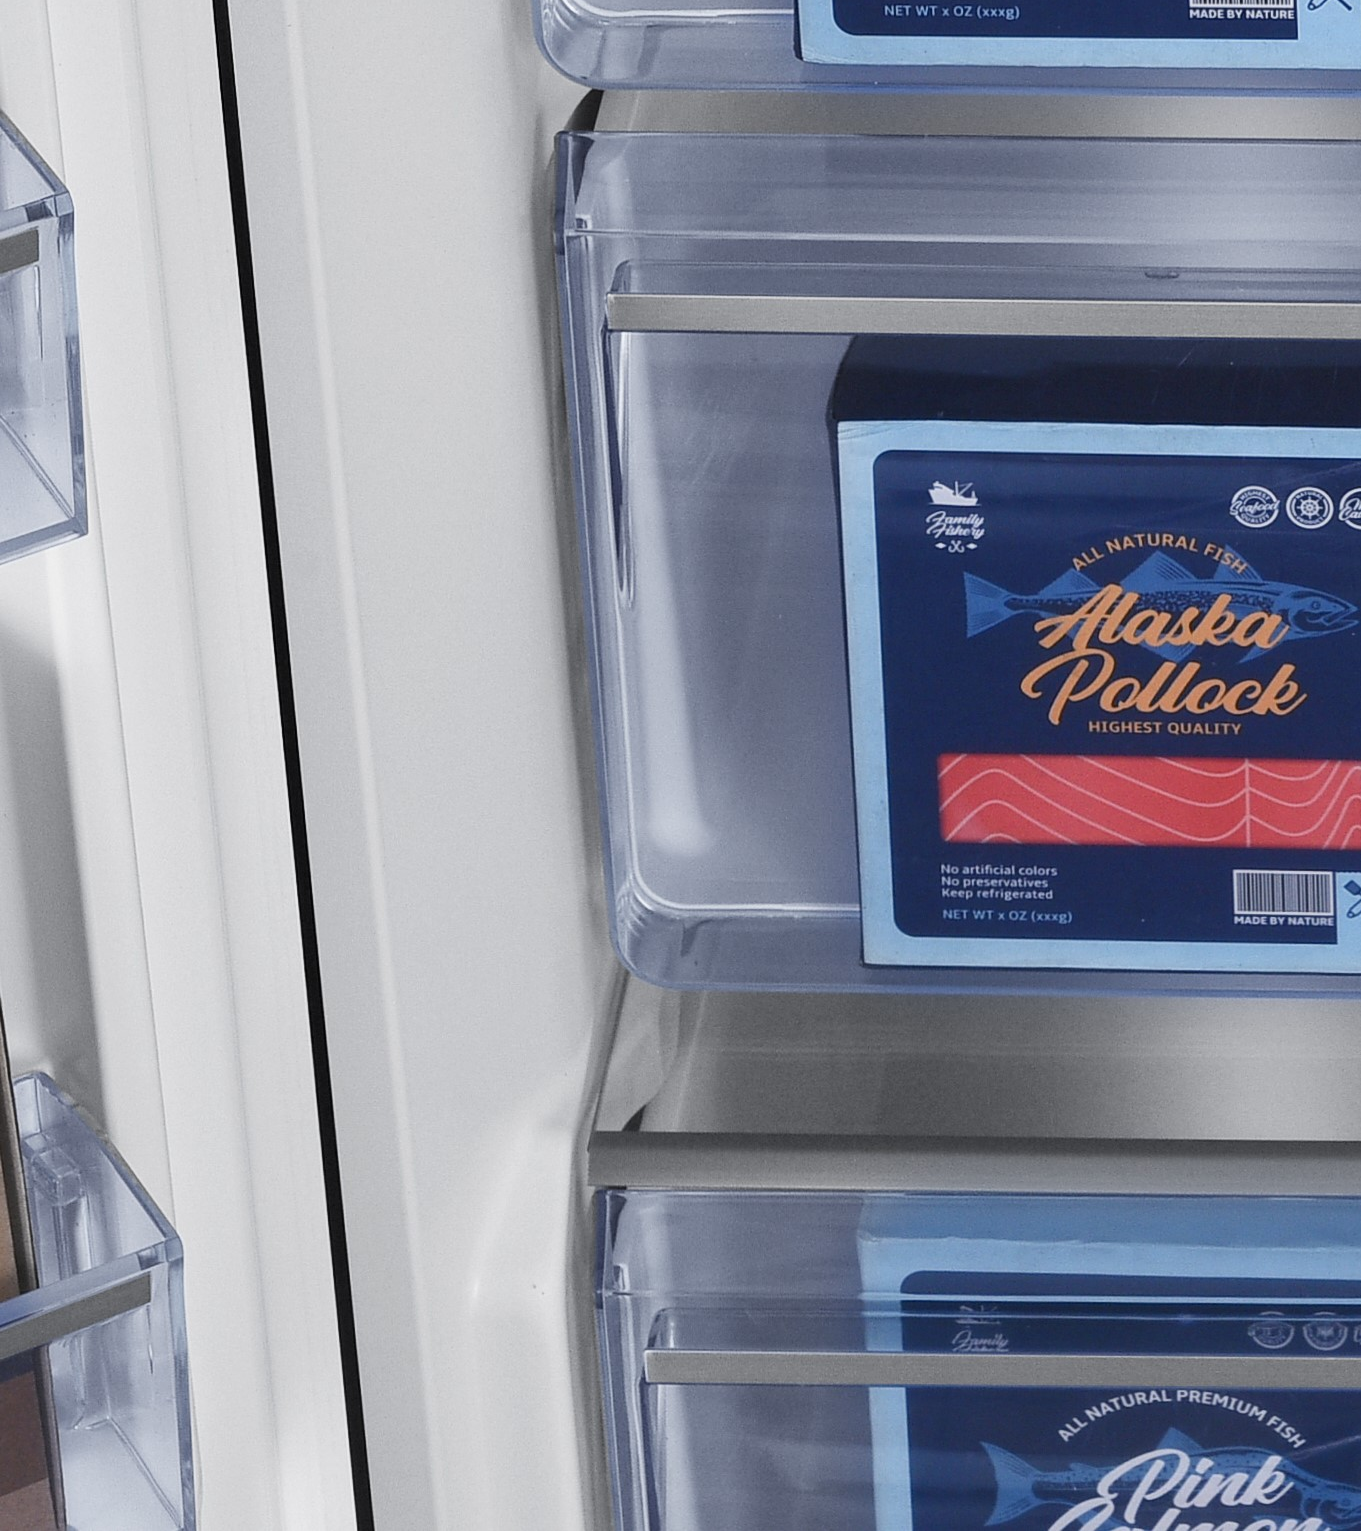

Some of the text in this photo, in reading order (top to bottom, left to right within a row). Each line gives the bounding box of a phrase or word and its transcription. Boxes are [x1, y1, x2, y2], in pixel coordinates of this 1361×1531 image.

[884, 5, 1020, 20] NET WT x OZ (xxxg)
[1189, 9, 1295, 19] MADE BY NATURE
[1240, 490, 1271, 501] HIGHEST
[1295, 491, 1323, 500] NATURAL
[1229, 500, 1281, 516] Seafood
[925, 510, 985, 528] Family
[1240, 513, 1270, 523] QUALITY
[926, 523, 985, 540] Fishery
[1072, 533, 1249, 575] ALL NATURAL FISH
[1034, 584, 1290, 651] Alaska
[1020, 648, 1308, 726] Pollock
[1089, 721, 1241, 735] HIGHEST QUALITY
[940, 864, 1058, 876] No artificial colors
[941, 876, 1049, 888] No preservatives
[941, 888, 1053, 901] Keep refrigerated
[943, 909, 1073, 924] NET WT x OZ (xxxg)
[1234, 916, 1334, 926] MADE BY NATURE
[951, 1329, 1009, 1348] Family
[1057, 1389, 1306, 1449] ALL NATURAL PREMIUM FISH
[1097, 1448, 1294, 1524] Pink
